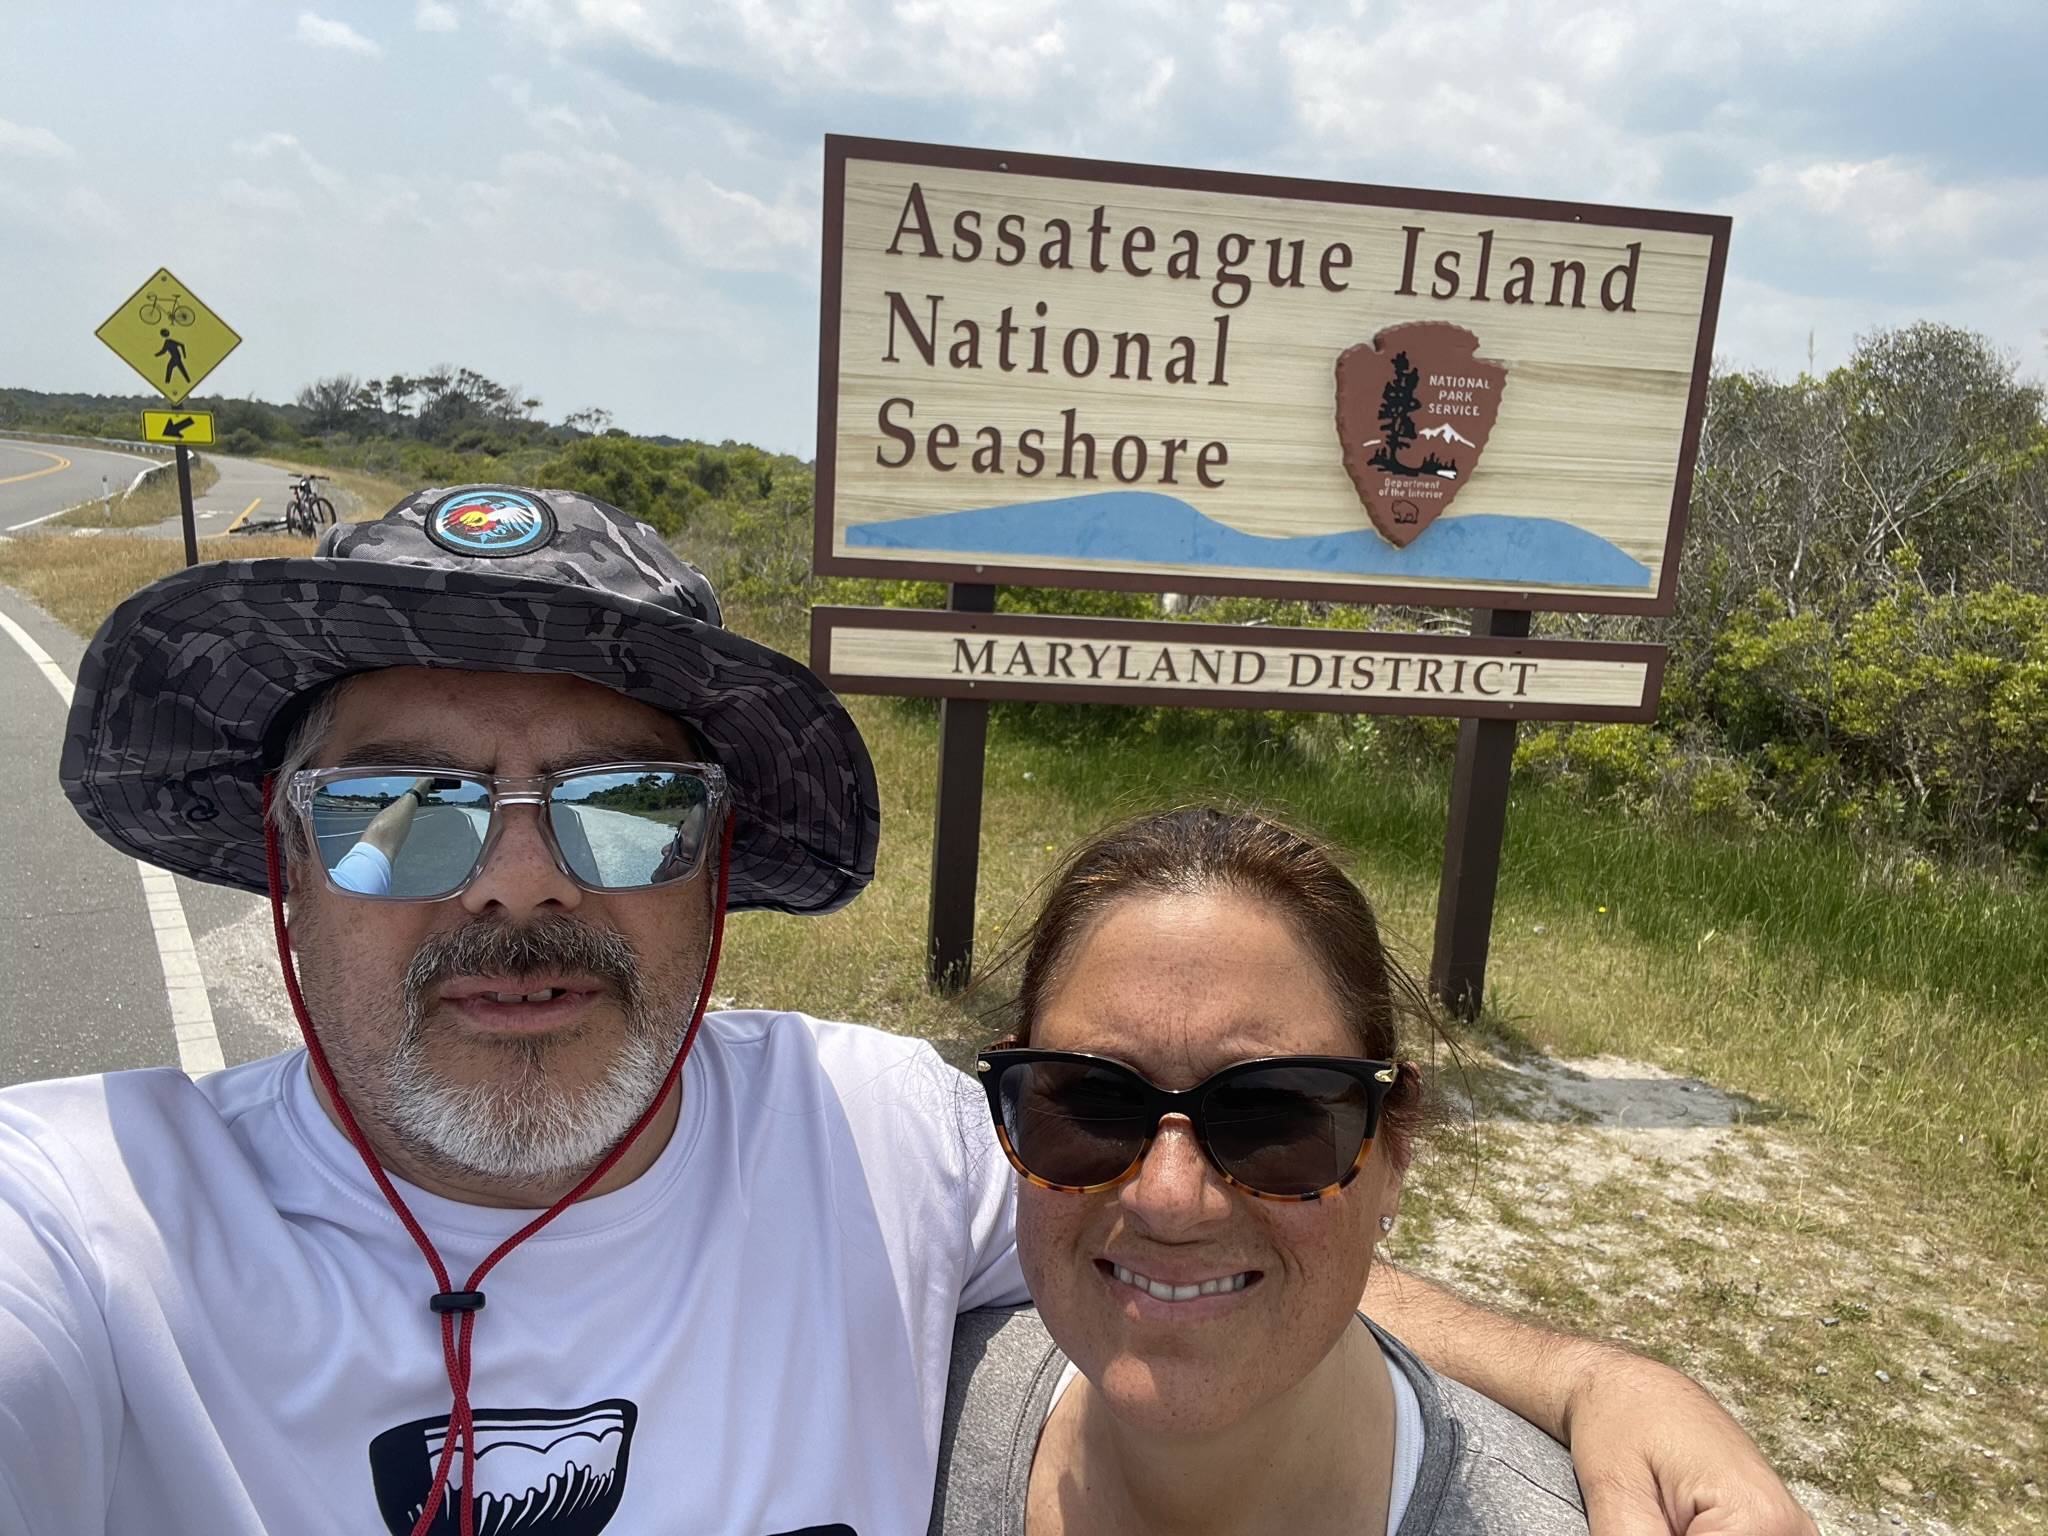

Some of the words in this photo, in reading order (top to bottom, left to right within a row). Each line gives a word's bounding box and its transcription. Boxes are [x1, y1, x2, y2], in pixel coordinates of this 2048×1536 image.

[885, 182, 1353, 308] Assateague
[1394, 225, 1642, 313] Island
[881, 290, 1230, 387] National
[1429, 375, 1491, 389] NATIONAL
[1438, 390, 1473, 402] PARK
[1428, 403, 1481, 416] SERVICE
[876, 398, 1229, 488] Seashore
[1384, 478, 1440, 489] Department
[1378, 488, 1390, 497] of
[1390, 488, 1405, 498] the
[1408, 488, 1444, 499] Interior
[952, 638, 1266, 686] MARYLAND
[1287, 653, 1539, 697] DISTRICT
